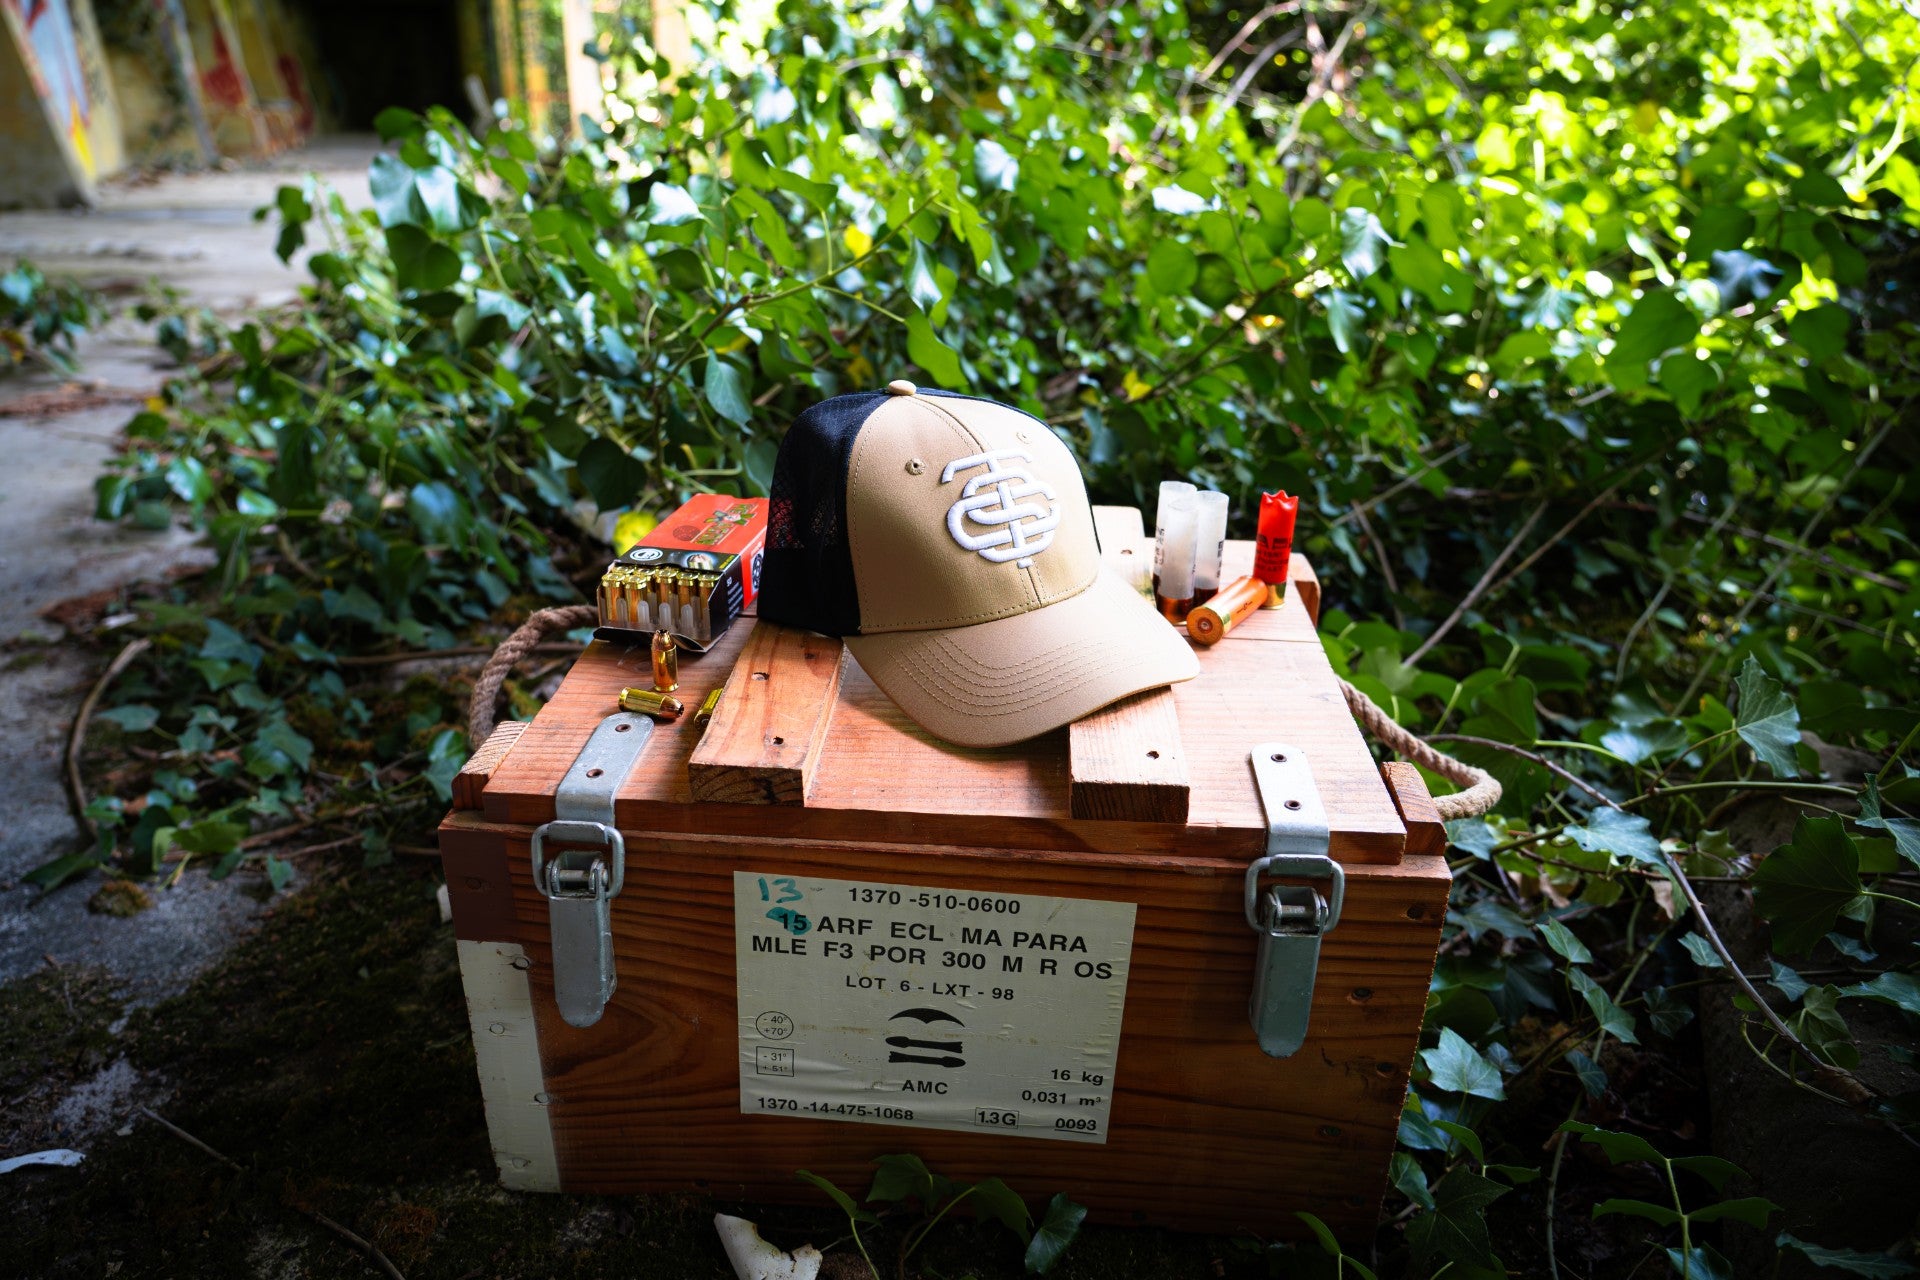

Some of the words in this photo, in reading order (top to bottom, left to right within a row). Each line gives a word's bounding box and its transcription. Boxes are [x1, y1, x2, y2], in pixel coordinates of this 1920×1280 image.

[758, 877, 803, 903] 13
[849, 888, 901, 905] 1370
[779, 914, 807, 930] 15
[817, 915, 873, 936] ARF
[891, 923, 944, 942] ECL
[961, 927, 1002, 946] MA
[1013, 932, 1088, 953] PARA
[752, 936, 807, 955] MLE
[823, 942, 853, 959] F3
[870, 945, 926, 964] POR
[942, 951, 986, 970] 300
[1002, 955, 1023, 973] M
[1039, 959, 1058, 975] R
[1075, 962, 1112, 980] OS
[846, 976, 885, 991] LOT
[1051, 1069, 1071, 1080] 16
[1082, 1071, 1104, 1086] kg
[902, 1080, 948, 1095] AMC
[1022, 1090, 1066, 1104] 0,031
[1055, 1118, 1097, 1130] 0093
